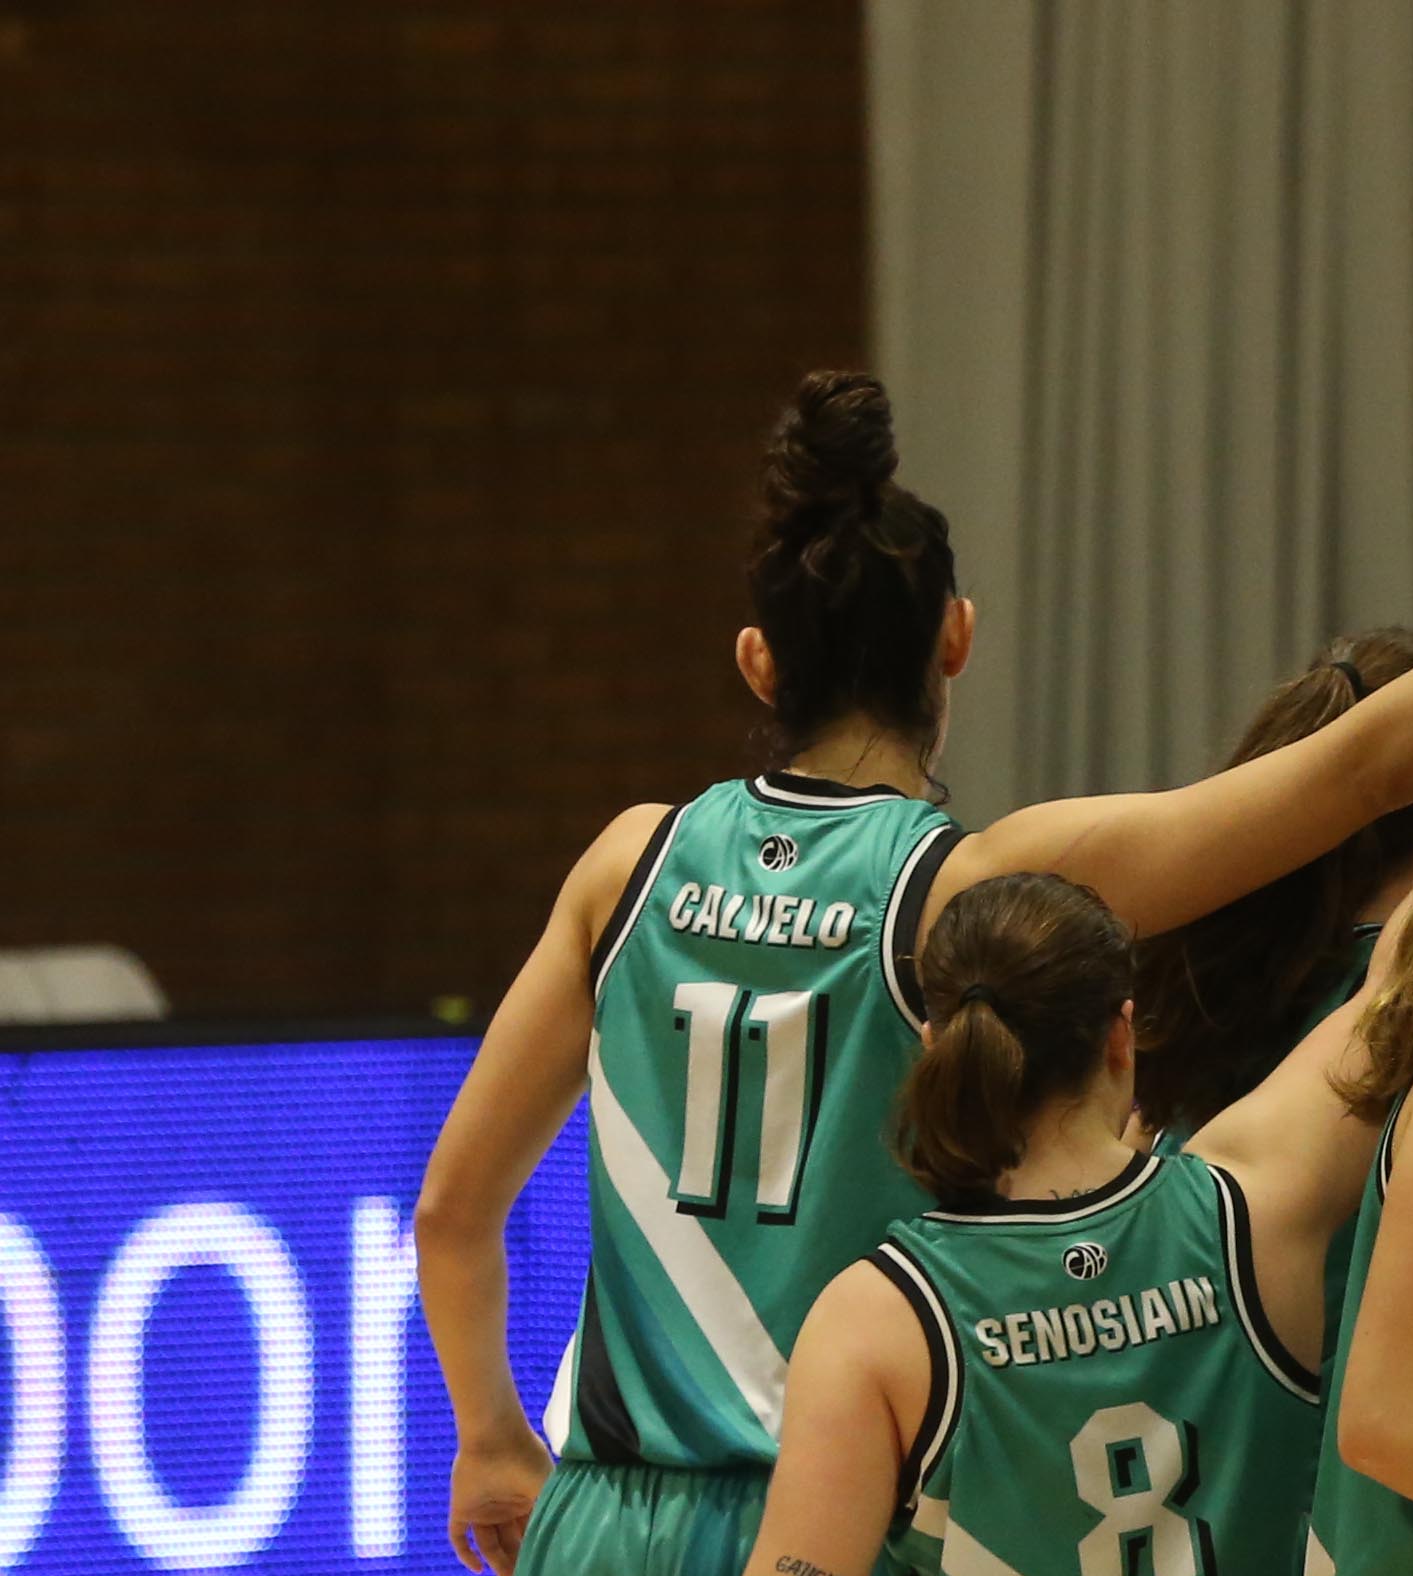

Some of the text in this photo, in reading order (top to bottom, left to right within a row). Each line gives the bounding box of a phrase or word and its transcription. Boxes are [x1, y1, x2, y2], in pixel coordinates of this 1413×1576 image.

[668, 881, 856, 949] CALVELO
[672, 980, 830, 1226] 11
[974, 1275, 1222, 1368] SENOSIAIN
